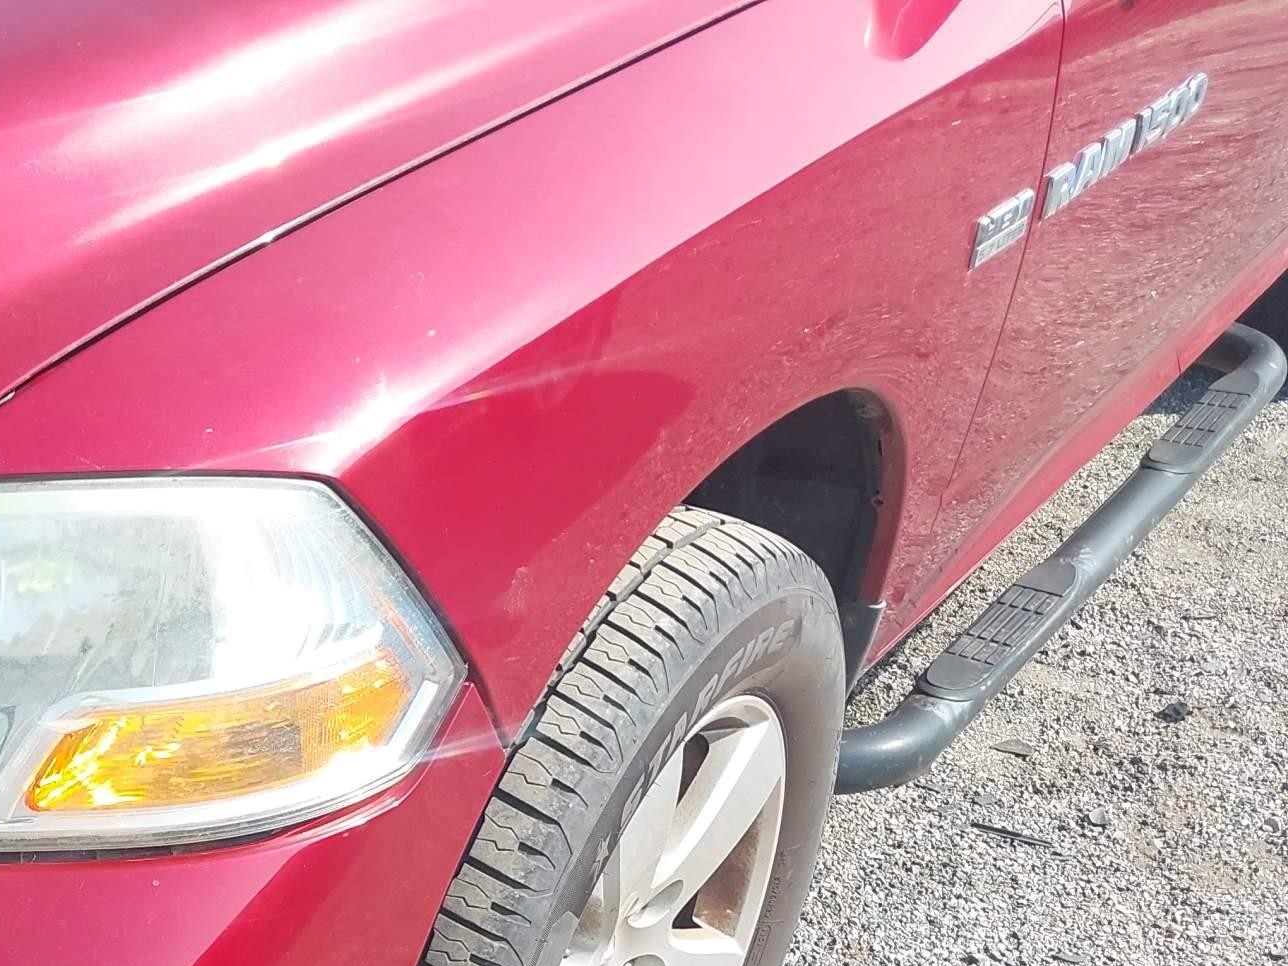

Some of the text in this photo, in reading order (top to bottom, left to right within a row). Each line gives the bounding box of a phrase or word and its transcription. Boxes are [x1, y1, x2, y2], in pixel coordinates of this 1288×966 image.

[1040, 72, 1208, 221] RAM 1500
[620, 618, 798, 834] STARFIRE
